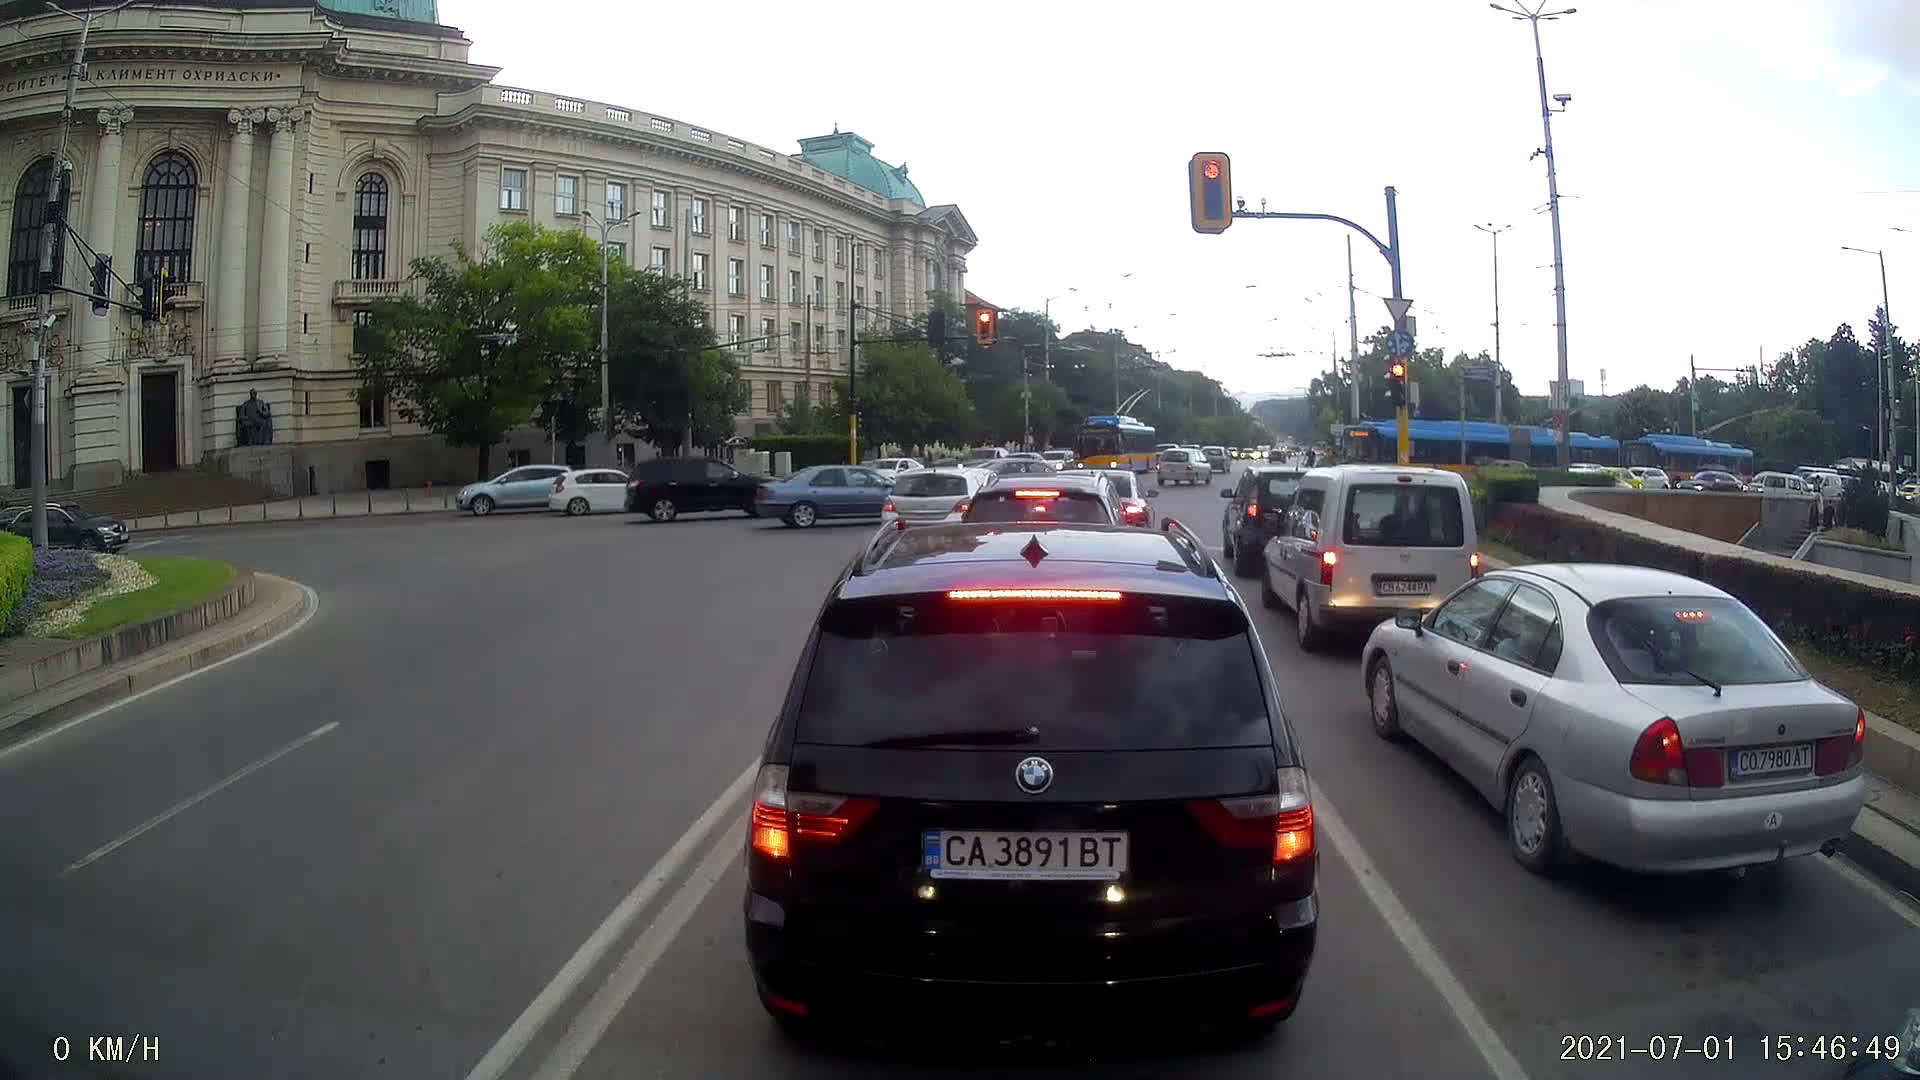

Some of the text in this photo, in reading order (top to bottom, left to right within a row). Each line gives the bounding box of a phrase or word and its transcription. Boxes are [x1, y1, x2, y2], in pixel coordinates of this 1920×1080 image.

[96, 69, 177, 81] КЛИМЕНТ
[182, 69, 273, 82] ОХРИДСКИ
[1741, 746, 1809, 771] CO 7980 AT
[946, 836, 1121, 867] CA 3891 BT
